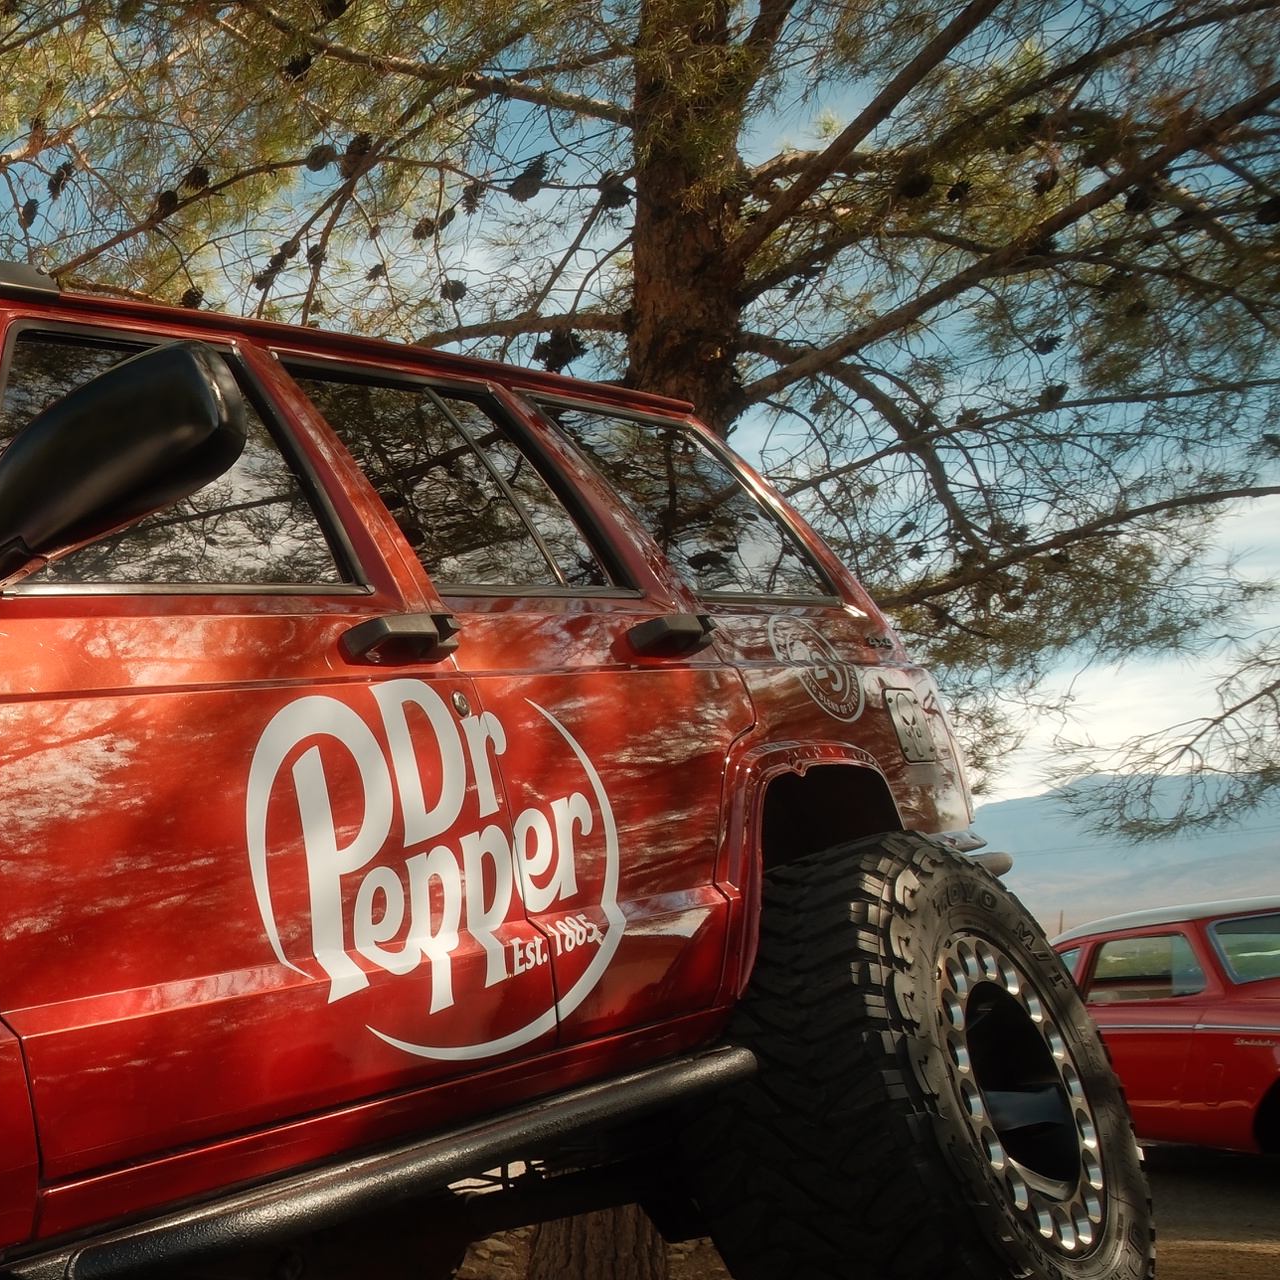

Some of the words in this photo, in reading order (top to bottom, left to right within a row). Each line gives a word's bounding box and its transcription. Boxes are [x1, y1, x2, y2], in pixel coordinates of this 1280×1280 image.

[369, 678, 507, 848] Dr
[246, 695, 593, 1015] Pepper
[510, 935, 548, 976] Est.
[546, 913, 604, 957] 1885
